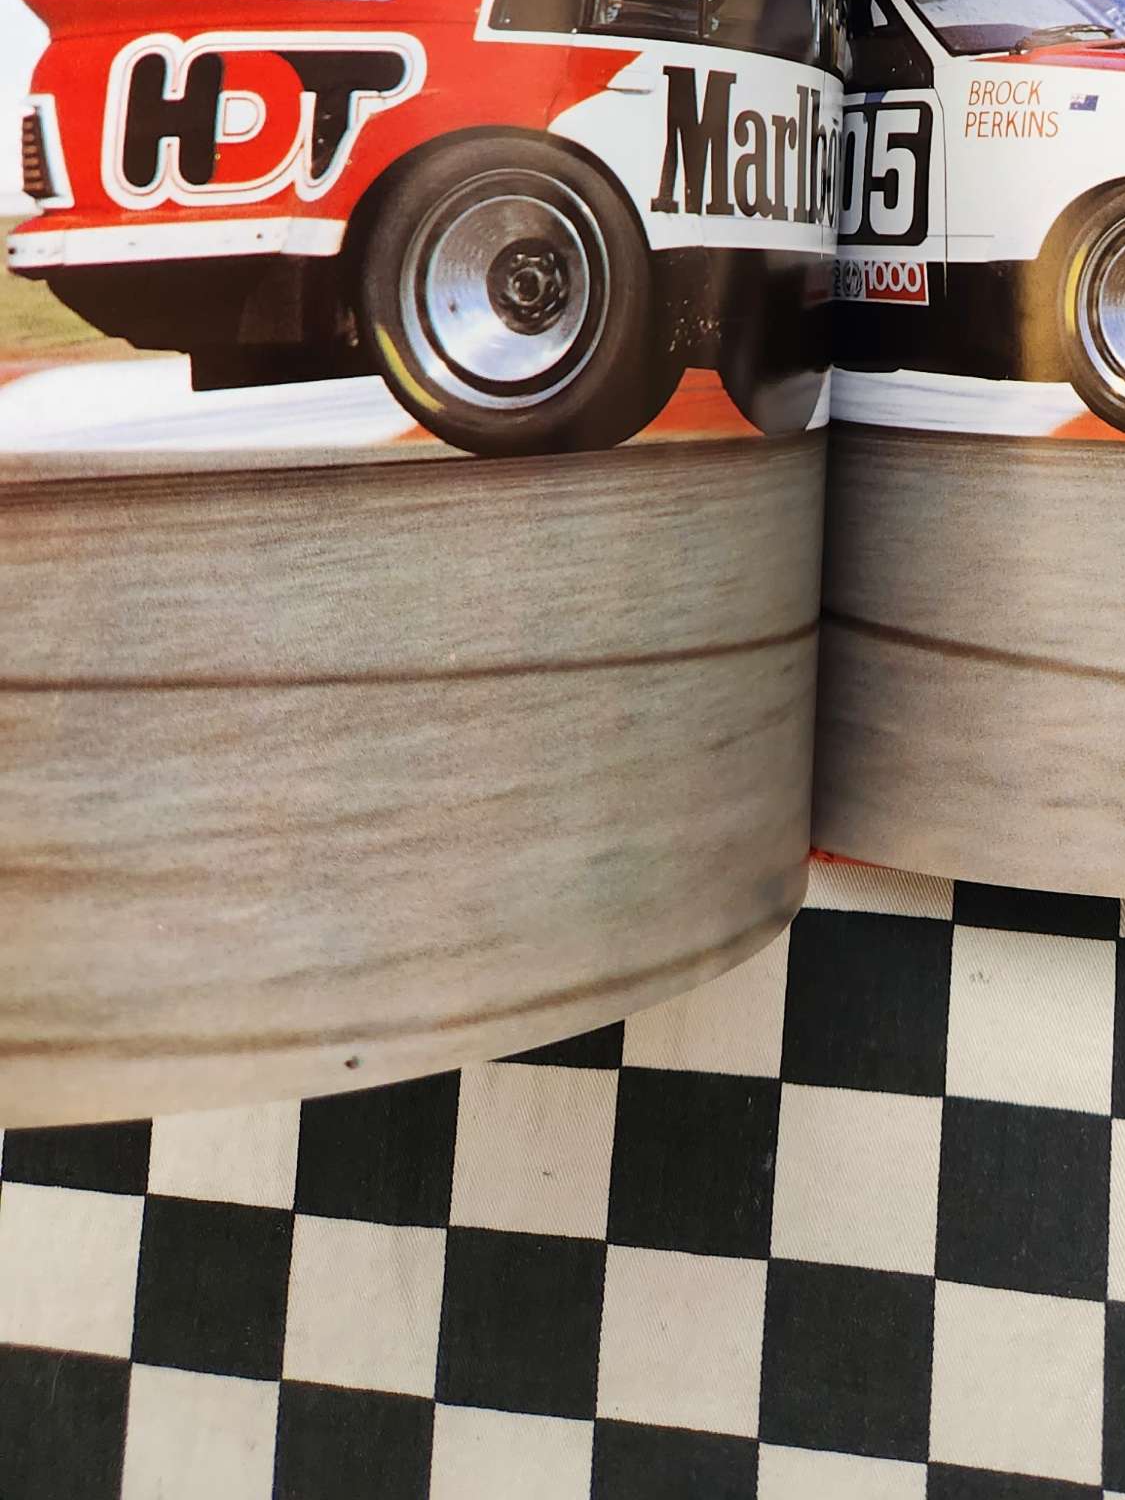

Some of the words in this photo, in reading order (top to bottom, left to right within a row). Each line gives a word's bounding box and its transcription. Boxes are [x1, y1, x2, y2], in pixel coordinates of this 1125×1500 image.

[968, 80, 1042, 106] BROCK
[112, 41, 417, 199] HDT
[964, 111, 1059, 138] PERKINS
[866, 260, 922, 293] 1000
